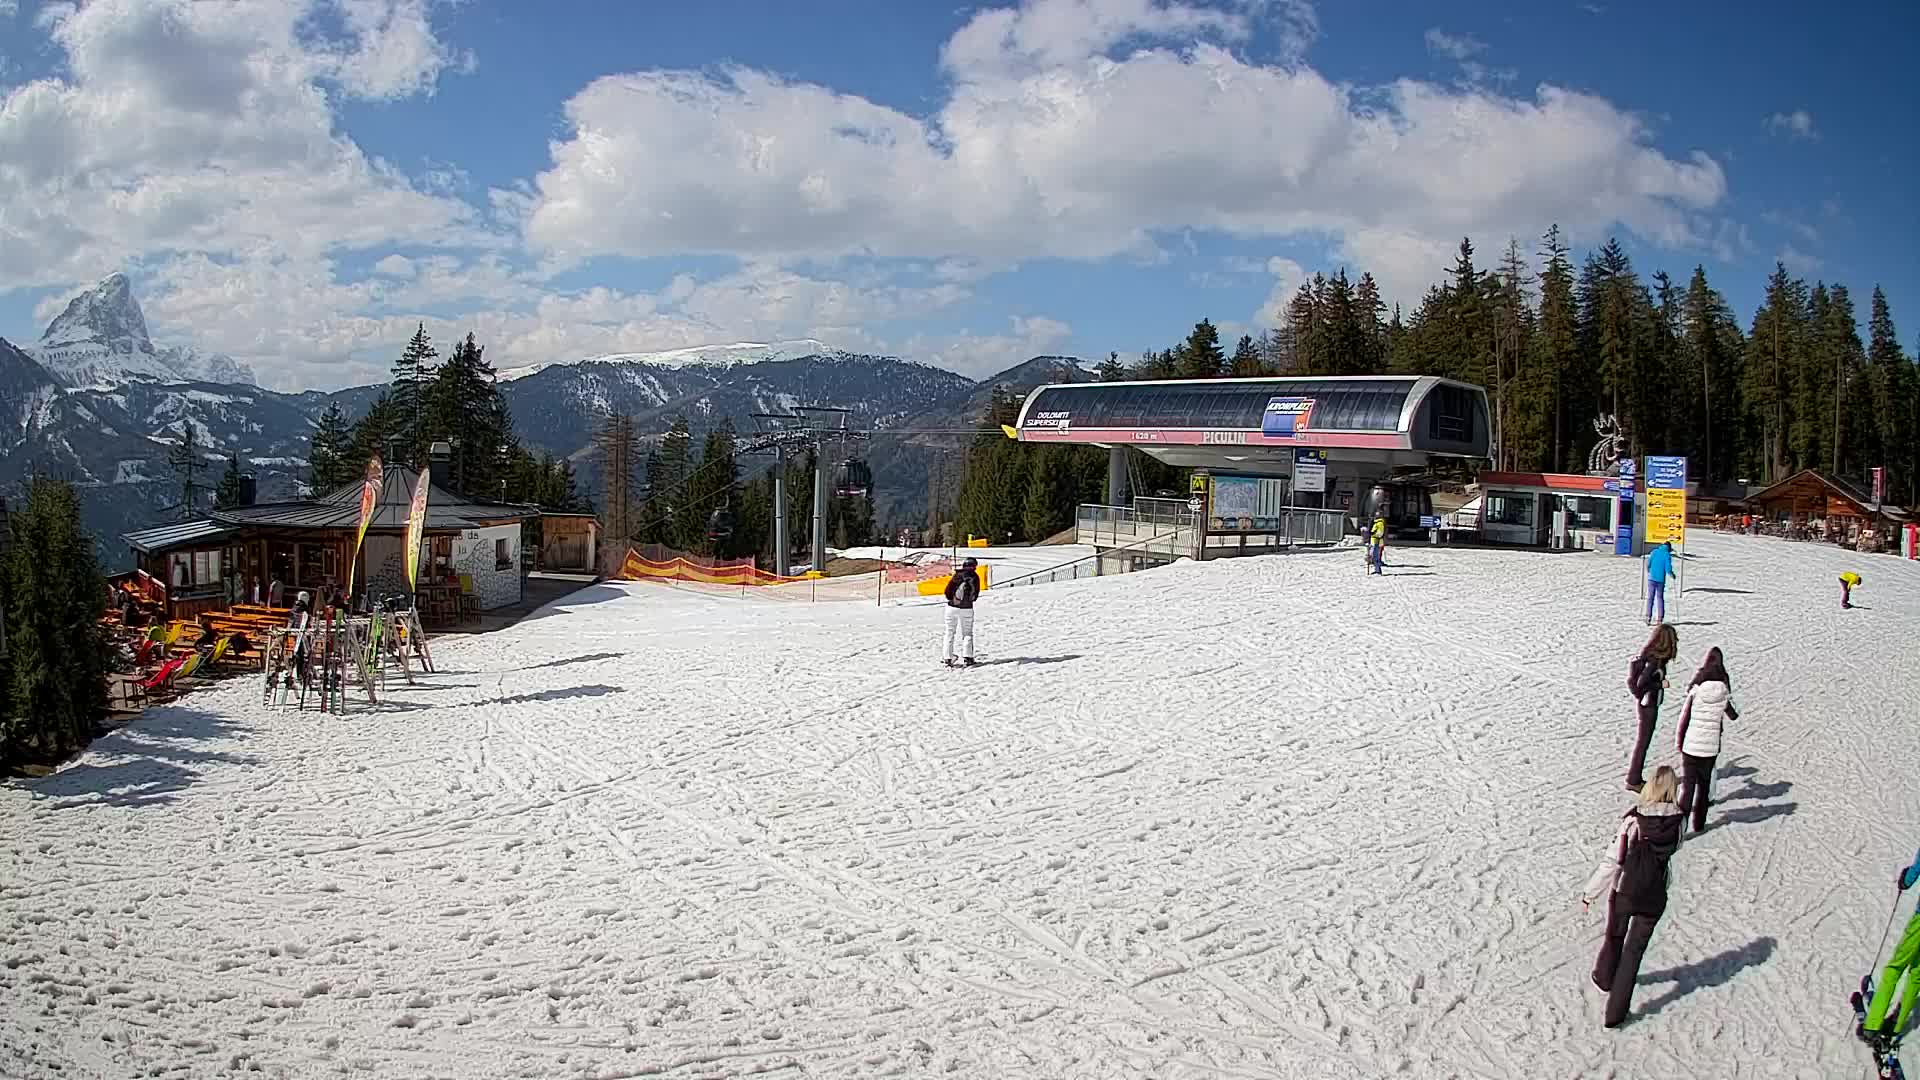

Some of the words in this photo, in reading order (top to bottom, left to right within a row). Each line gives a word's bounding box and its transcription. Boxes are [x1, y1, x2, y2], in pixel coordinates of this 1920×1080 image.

[1037, 411, 1070, 419] DOLOMITI
[1131, 432, 1149, 440] 1620
[1203, 431, 1246, 444] PICULIN
